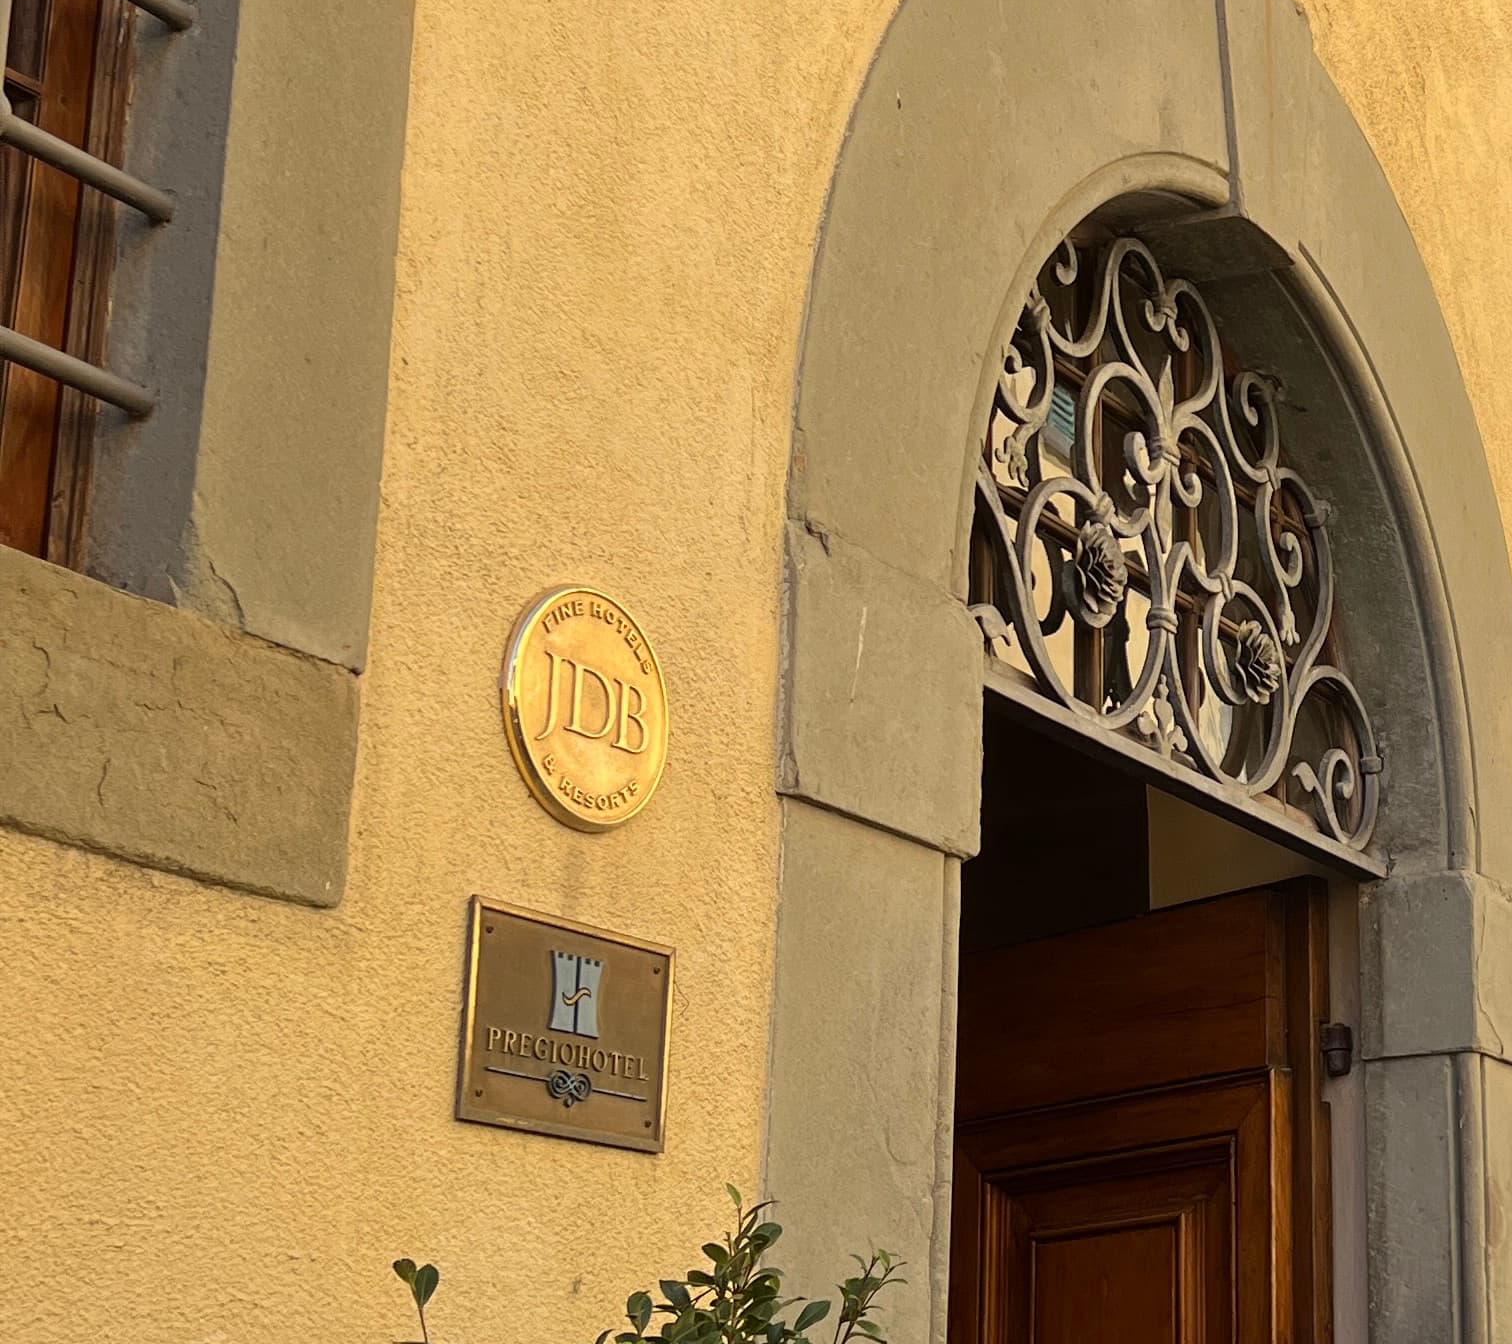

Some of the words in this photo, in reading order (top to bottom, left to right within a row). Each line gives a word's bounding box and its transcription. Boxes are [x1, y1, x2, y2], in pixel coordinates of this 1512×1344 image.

[542, 600, 585, 634] FINE
[591, 601, 654, 675] HOTELS
[535, 649, 650, 754] JDB
[542, 753, 556, 776] &
[558, 775, 641, 811] RESORTS
[486, 1025, 650, 1082] PREGIOHOTEL
